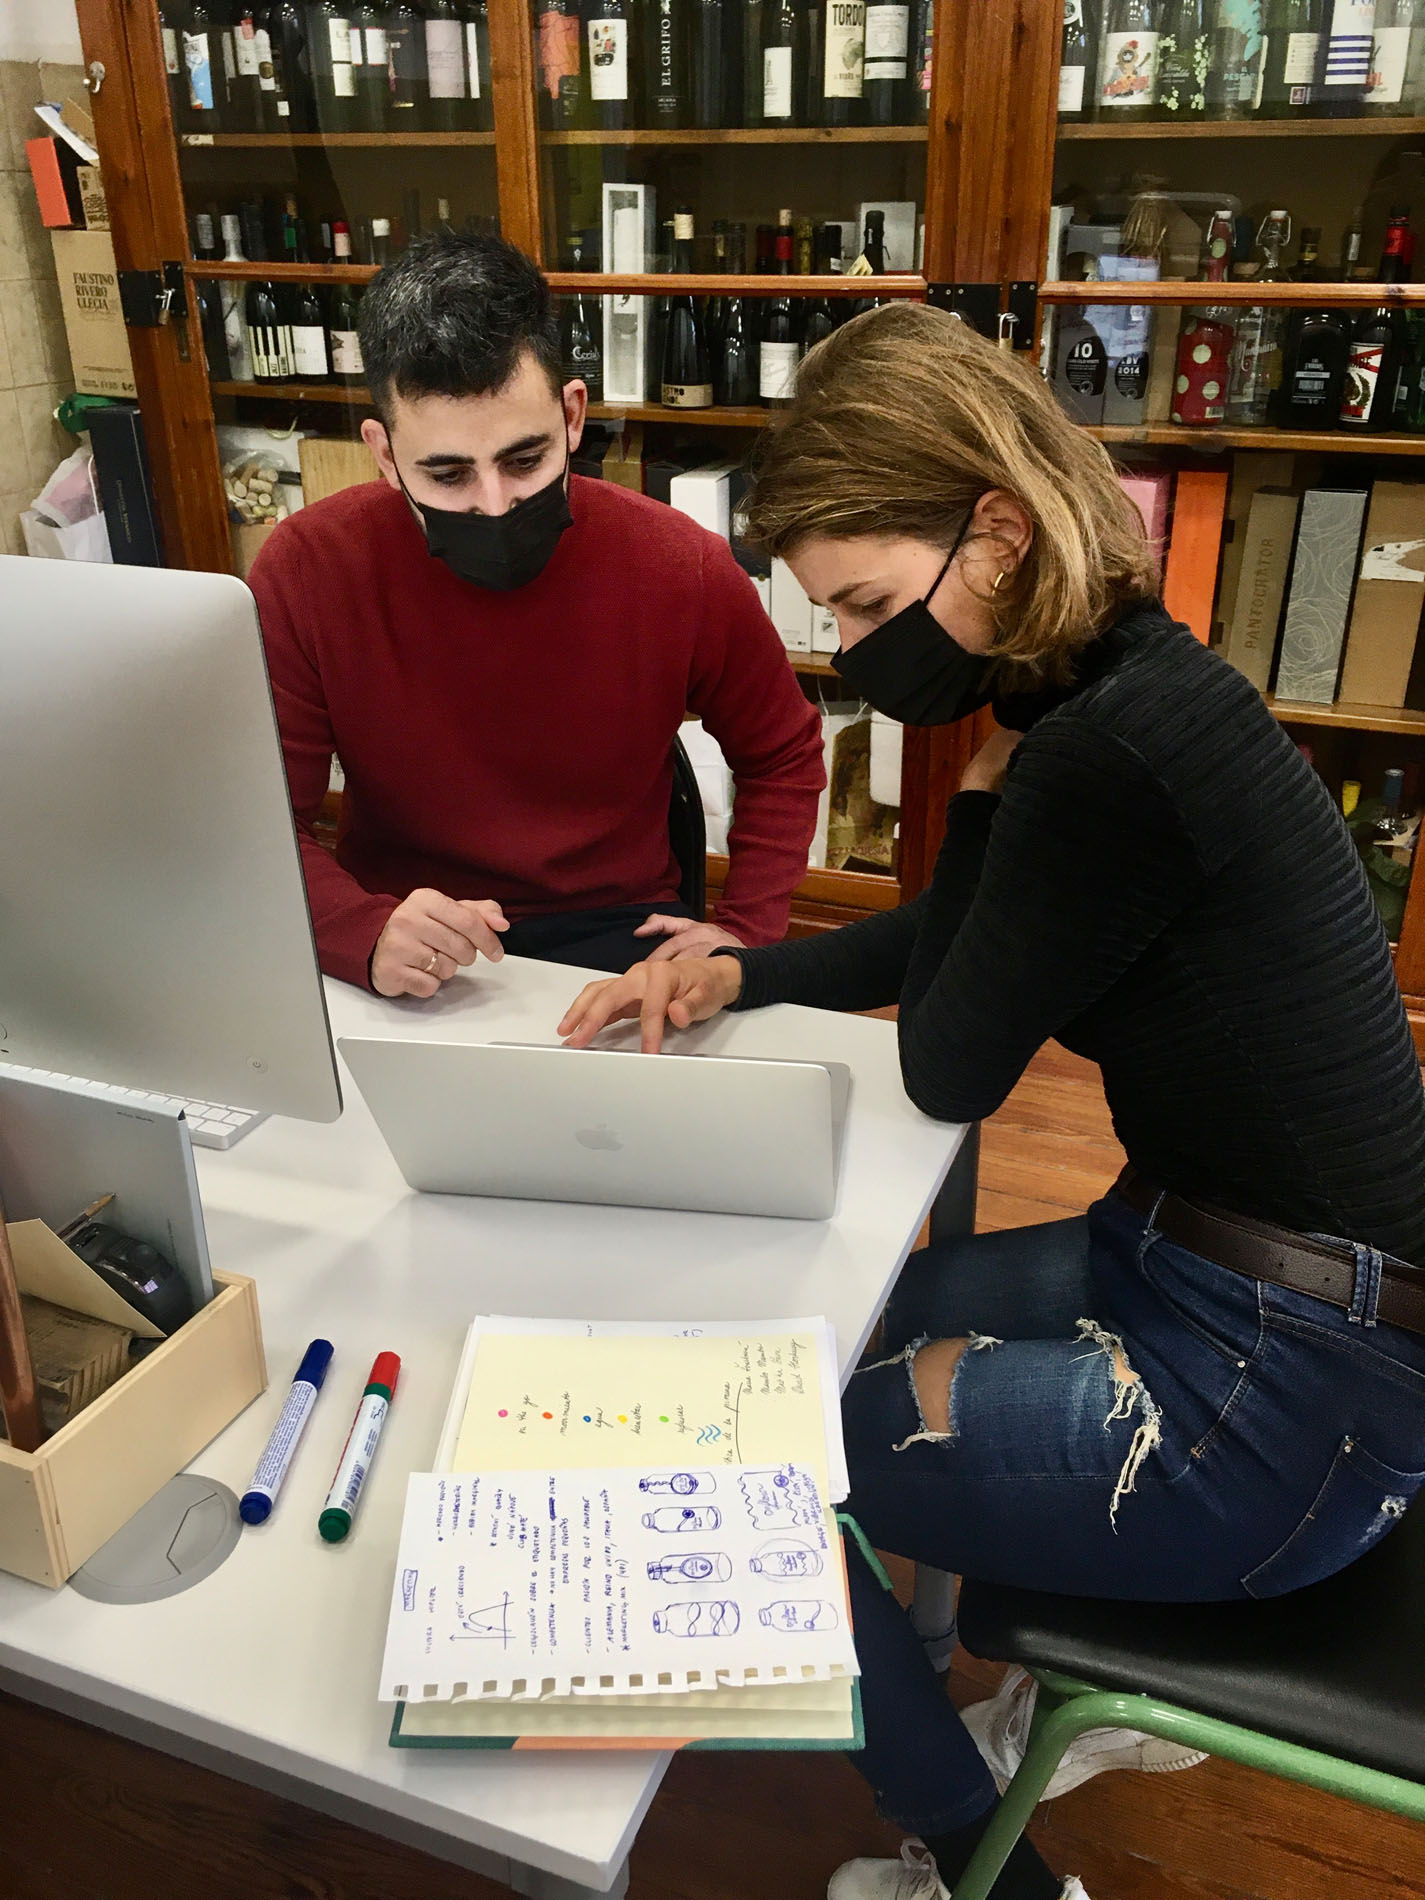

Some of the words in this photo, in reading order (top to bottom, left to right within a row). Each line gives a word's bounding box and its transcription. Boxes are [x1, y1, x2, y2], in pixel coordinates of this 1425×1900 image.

[661, 18, 672, 67] GRIFO
[661, 68, 672, 87] EL
[76, 285, 108, 297] RIVERO
[1074, 342, 1093, 359] 10
